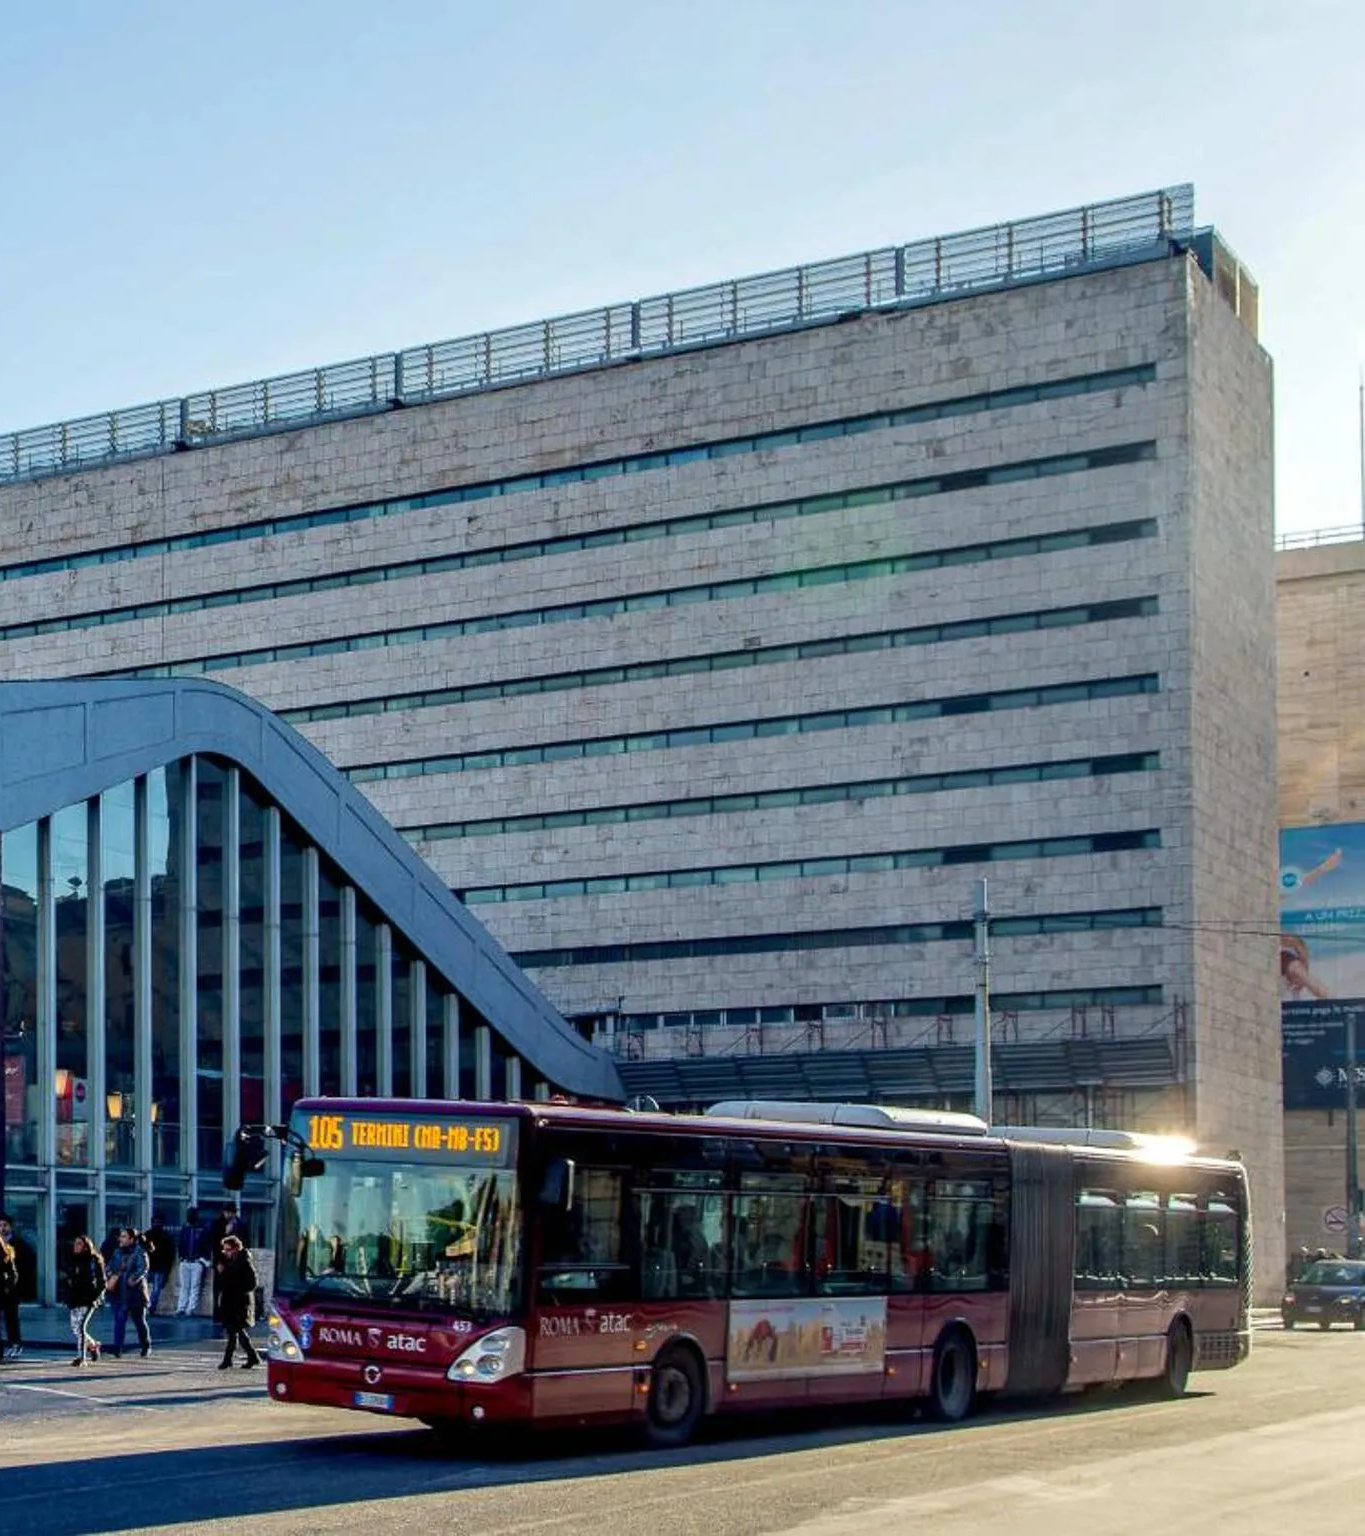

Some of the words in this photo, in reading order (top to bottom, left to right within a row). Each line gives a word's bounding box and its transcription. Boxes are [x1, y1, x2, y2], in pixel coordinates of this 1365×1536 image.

[309, 1115, 343, 1150] 105
[351, 1121, 410, 1148] TERMINI
[452, 1320, 473, 1333] 453
[539, 1315, 580, 1337] ROMA
[599, 1312, 632, 1334] atac
[319, 1327, 363, 1347] ROMA
[387, 1333, 427, 1353] atac
